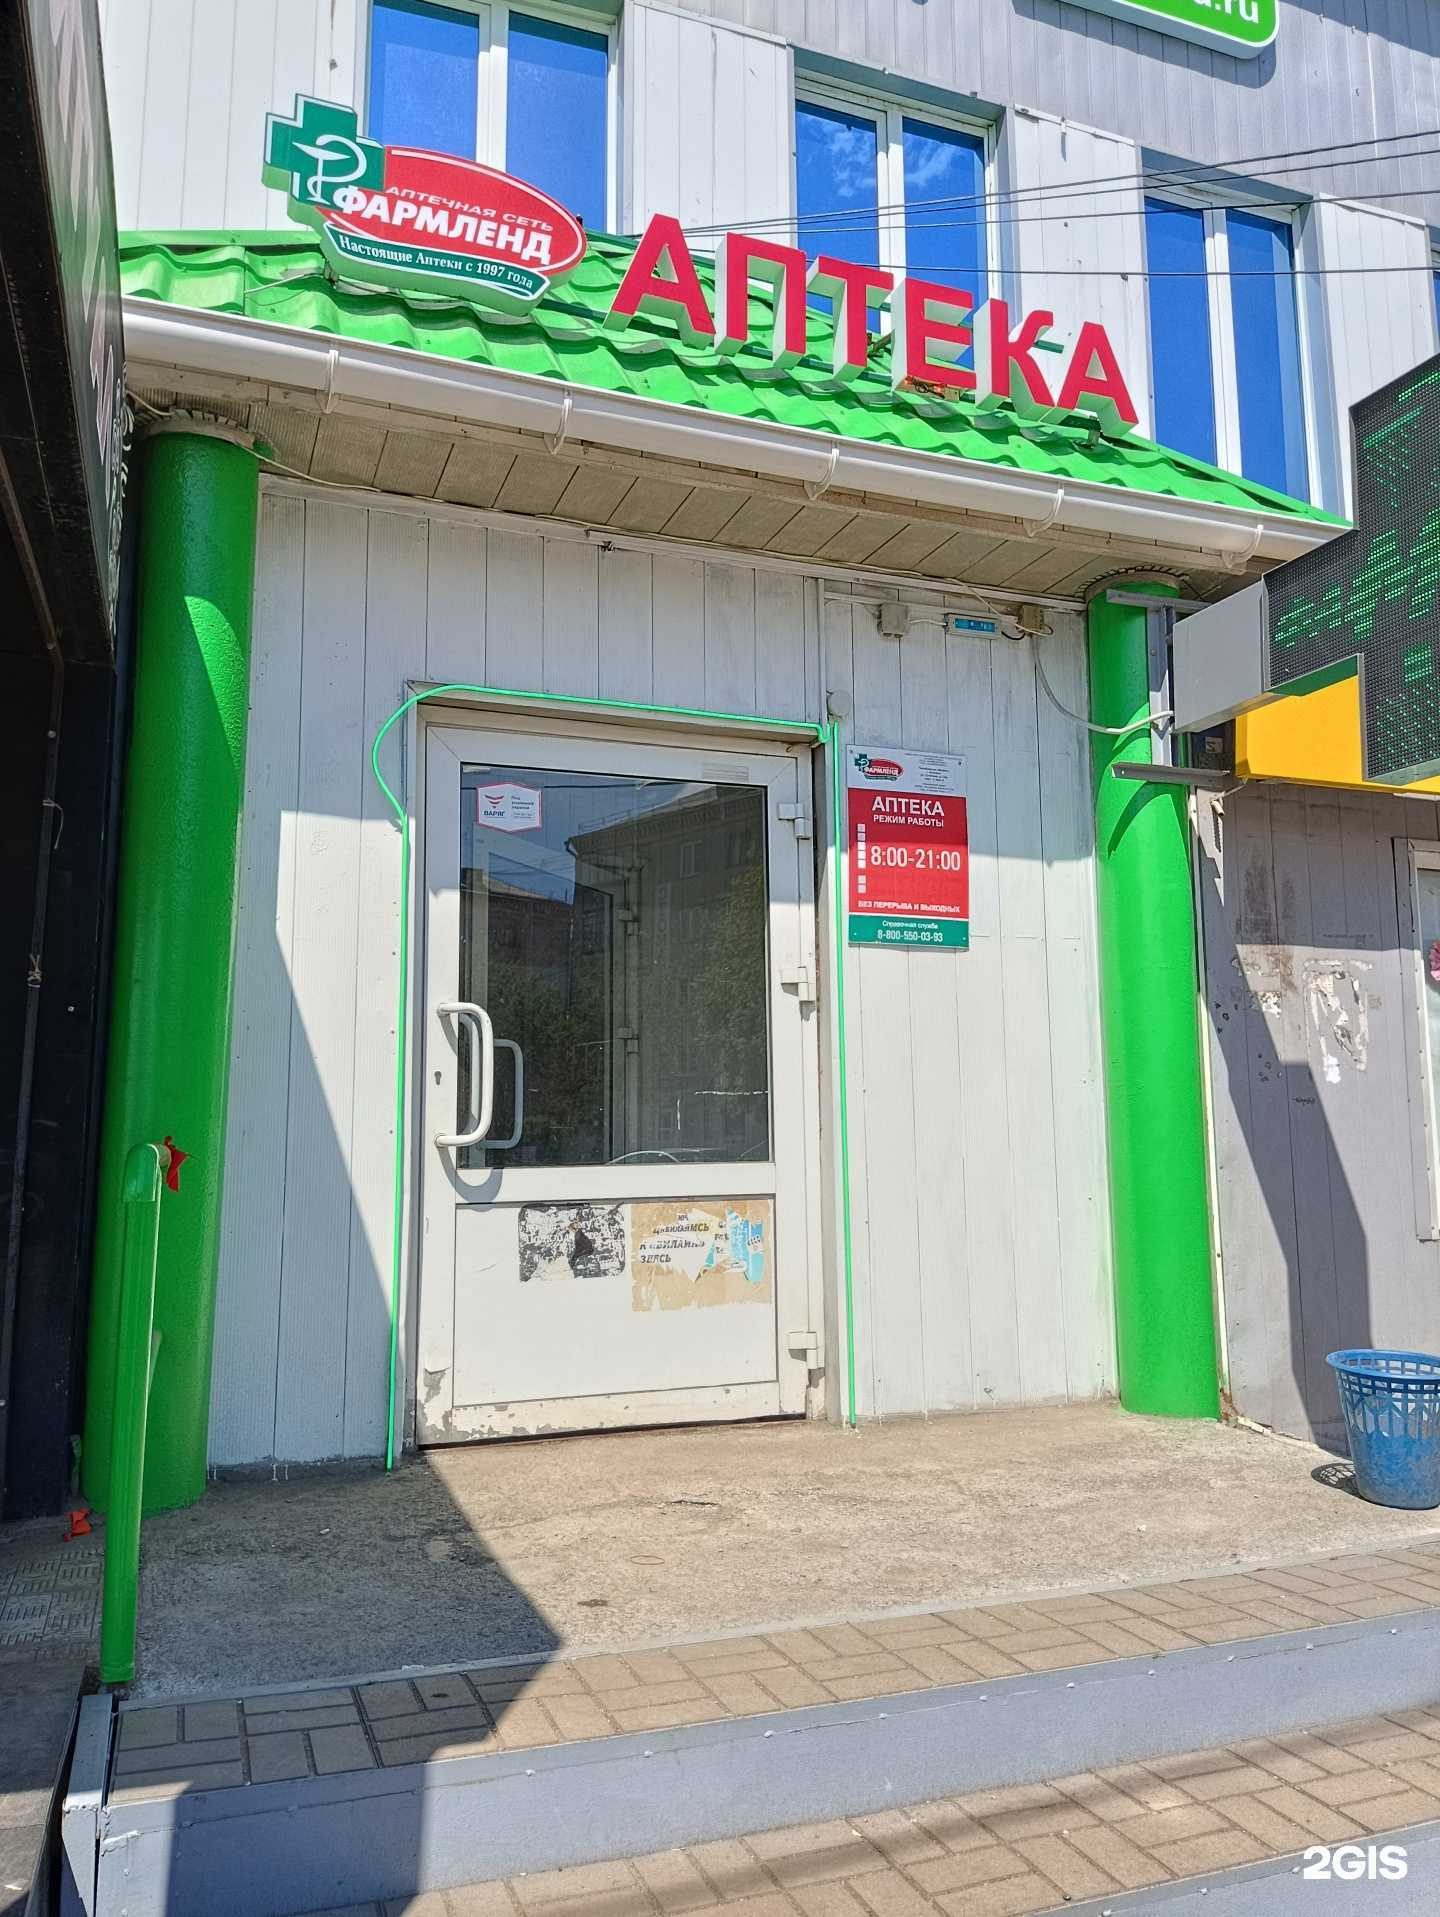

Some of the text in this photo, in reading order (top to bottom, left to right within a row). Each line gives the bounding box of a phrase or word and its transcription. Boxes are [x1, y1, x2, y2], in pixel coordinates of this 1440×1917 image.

[385, 186, 554, 231] АПТЕЧНАЯ СЕТЬ
[333, 185, 552, 265] ФАРМЛЕНД
[339, 236, 534, 289] Настоящие Аптеки с 1997 года
[609, 213, 1139, 425] АПТЕКА
[872, 796, 945, 817] АПТЕКА
[873, 815, 944, 827] РЕЖИМ РАБОТЫ
[871, 845, 961, 871] 8:00-21:00
[858, 900, 872, 908] БЕЗ
[874, 901, 912, 910] ПЕРЕРЫВА
[920, 903, 961, 913] ВЫХОДНЫХ
[877, 929, 943, 942] 8-800-550-03-93
